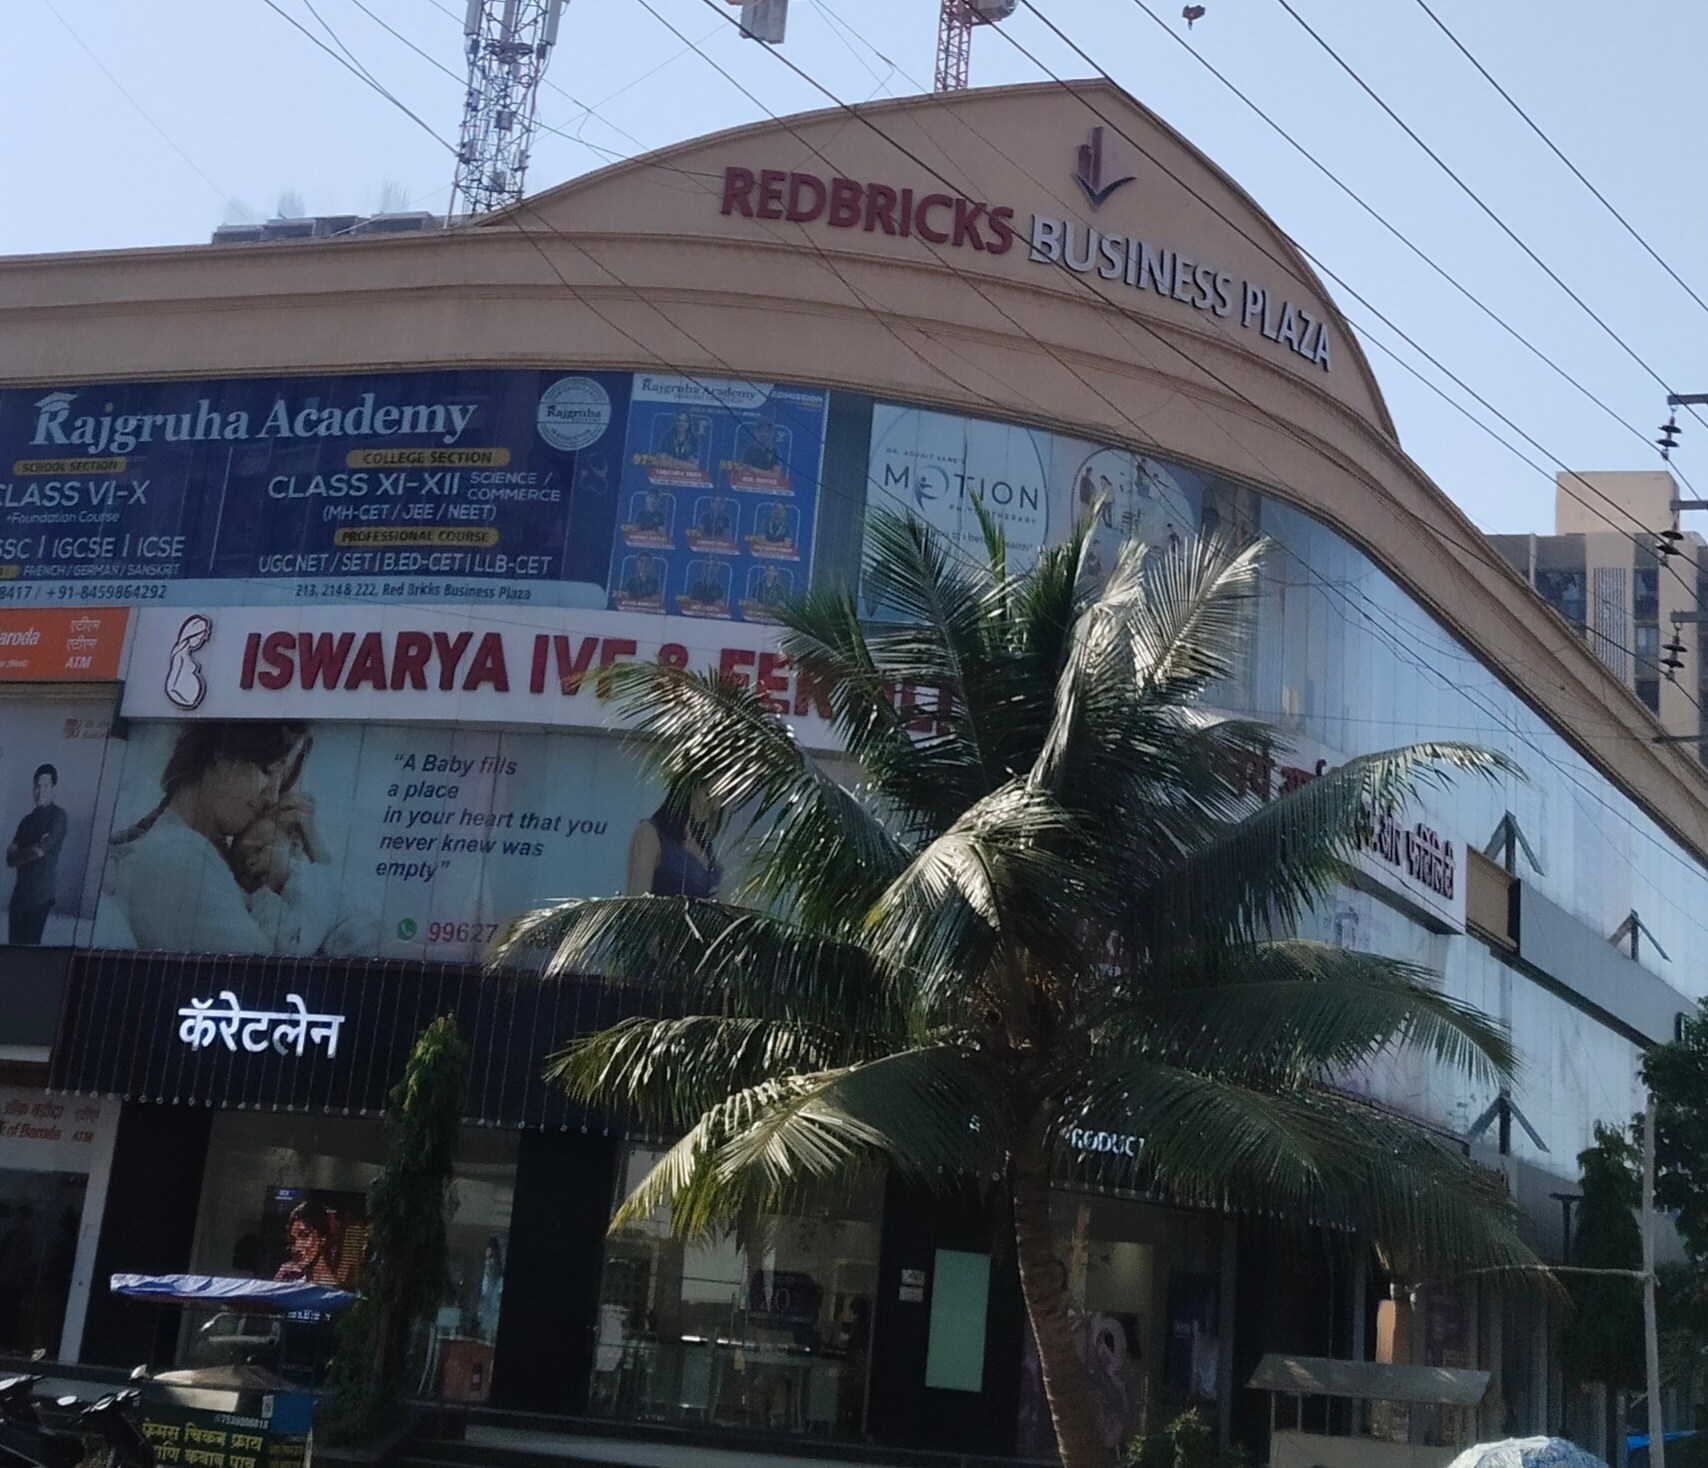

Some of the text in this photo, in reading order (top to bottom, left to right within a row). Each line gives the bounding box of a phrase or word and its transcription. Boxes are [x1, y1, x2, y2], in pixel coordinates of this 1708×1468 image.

[720, 166, 1332, 373] REDBRICKS BUSINESS PLAZA
[29, 393, 478, 454] Rajgruha Academy
[22, 460, 118, 473] SCHOOL SECTION
[363, 451, 493, 466] COLLEGE SECTION
[268, 472, 460, 499] CLASS XI-XII
[470, 471, 538, 485] SCIENCE
[884, 463, 1039, 511] MOTION
[88, 479, 150, 506] VI-X
[467, 488, 562, 502] COMMERCE
[80, 510, 120, 523] Course
[323, 504, 389, 522] (MH-CET
[403, 504, 434, 520] JEE
[448, 503, 497, 521] NEET)
[53, 536, 116, 558] IGCSE
[137, 535, 186, 557] ICSE
[341, 529, 489, 543] PROFESSIONAL COURSE
[383, 583, 405, 596] Red
[408, 583, 441, 596] Bricks
[443, 583, 497, 599] Business
[499, 586, 532, 600] Plaza
[64, 656, 92, 670] ATM
[239, 631, 510, 693] ISWARYA
[529, 634, 637, 700] IVF
[422, 755, 472, 777] Baby
[479, 756, 517, 776] fills
[387, 781, 459, 801] a place
[383, 805, 608, 837] in your heart that you
[379, 834, 545, 857] never knew was
